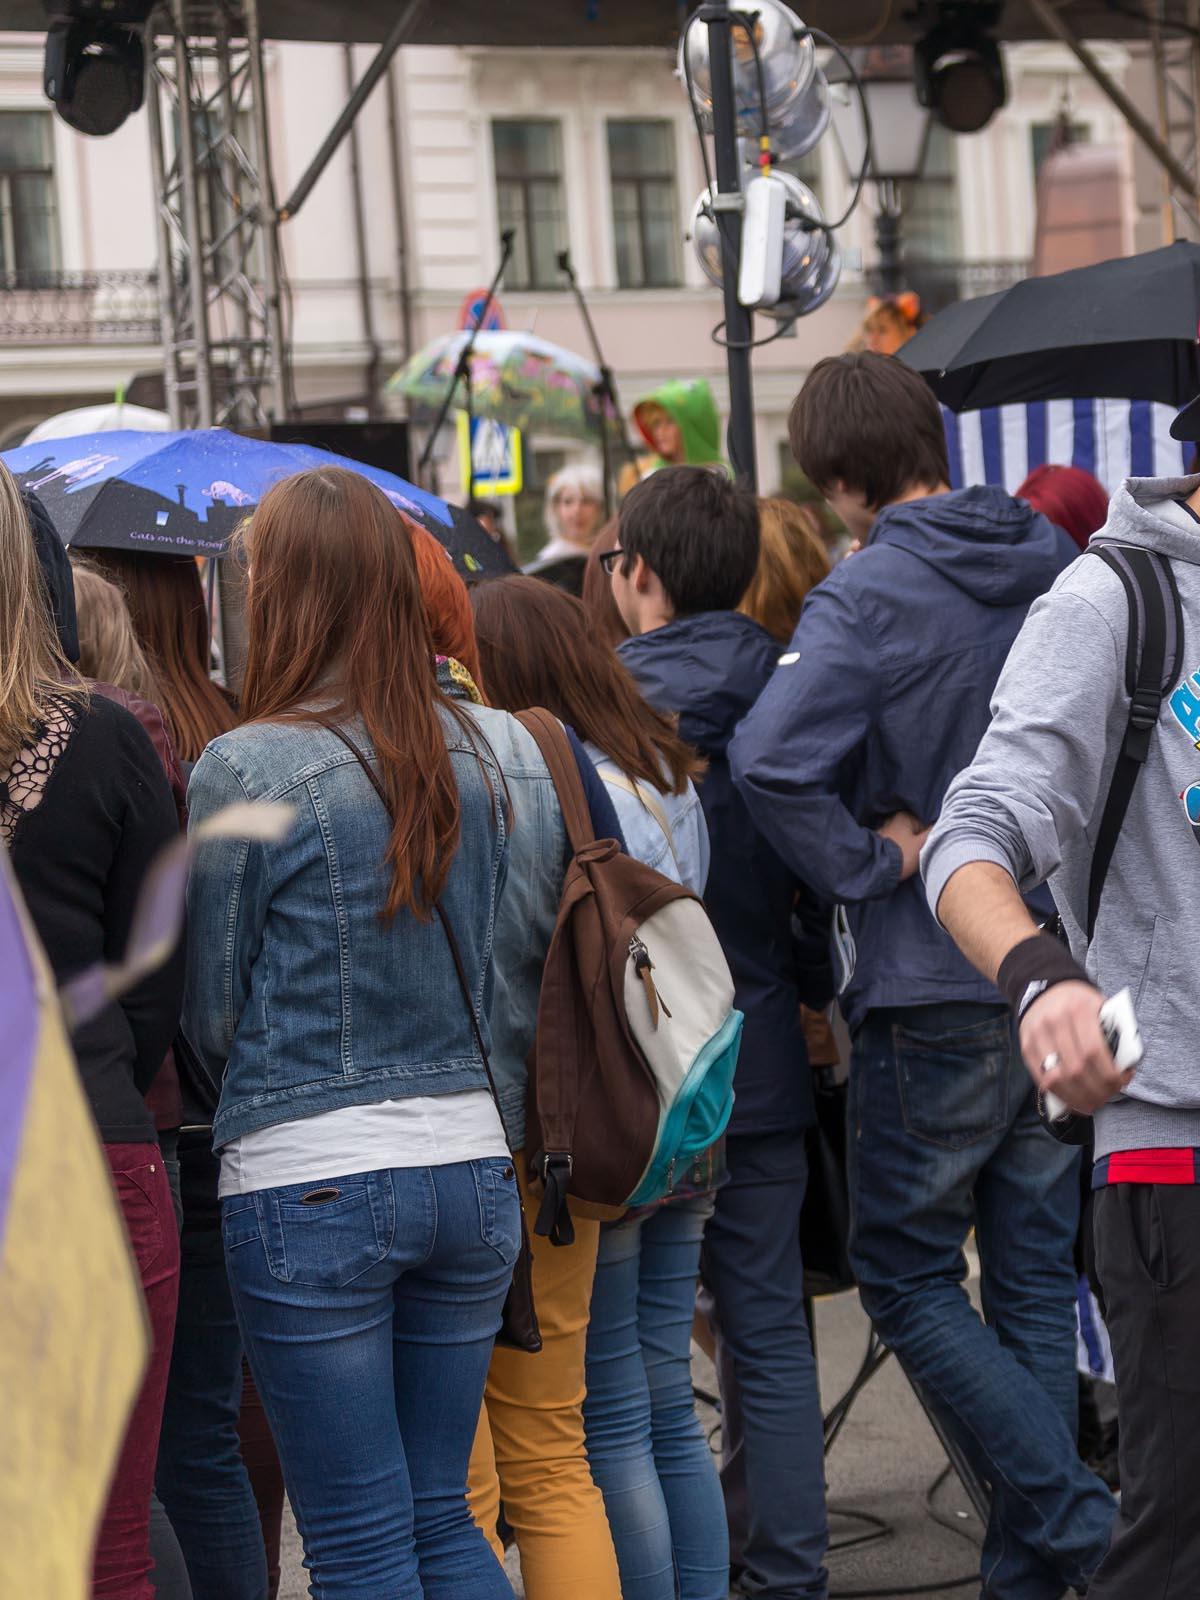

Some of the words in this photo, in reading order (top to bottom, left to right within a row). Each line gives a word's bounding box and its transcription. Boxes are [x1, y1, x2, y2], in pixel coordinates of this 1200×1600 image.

[129, 530, 155, 542] Cats
[157, 535, 174, 544] on
[176, 535, 196, 546] the
